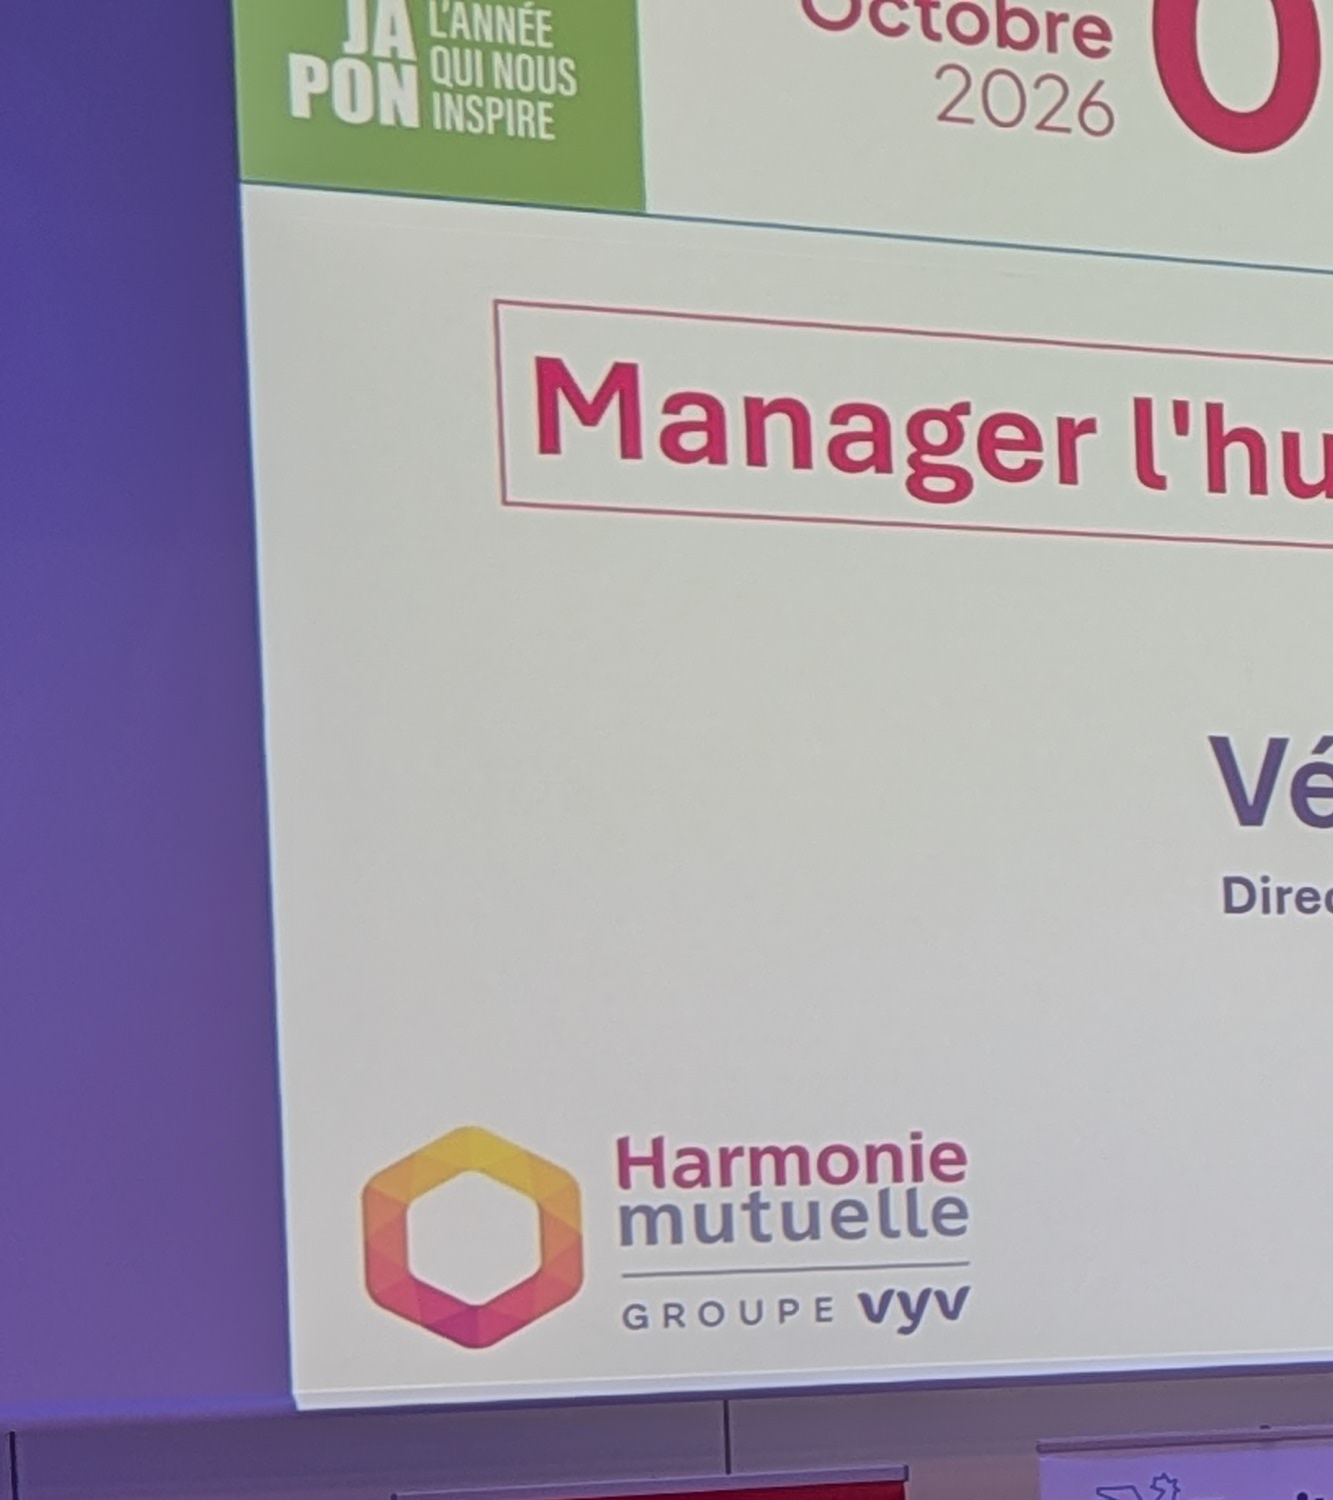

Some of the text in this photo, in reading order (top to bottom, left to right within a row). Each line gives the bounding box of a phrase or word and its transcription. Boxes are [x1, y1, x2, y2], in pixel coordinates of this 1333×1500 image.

[343, 0, 417, 61] JA
[428, 0, 554, 49] L'ANNÉE
[288, 51, 420, 129] PON
[430, 44, 578, 97] QUI NOUS
[933, 62, 1116, 138] 2026
[432, 91, 556, 141] INSPIRE
[533, 354, 1100, 506] Manager
[614, 1130, 969, 1191] Harmonie
[617, 1186, 970, 1248] mutuelle
[621, 1295, 836, 1331] GROUPE
